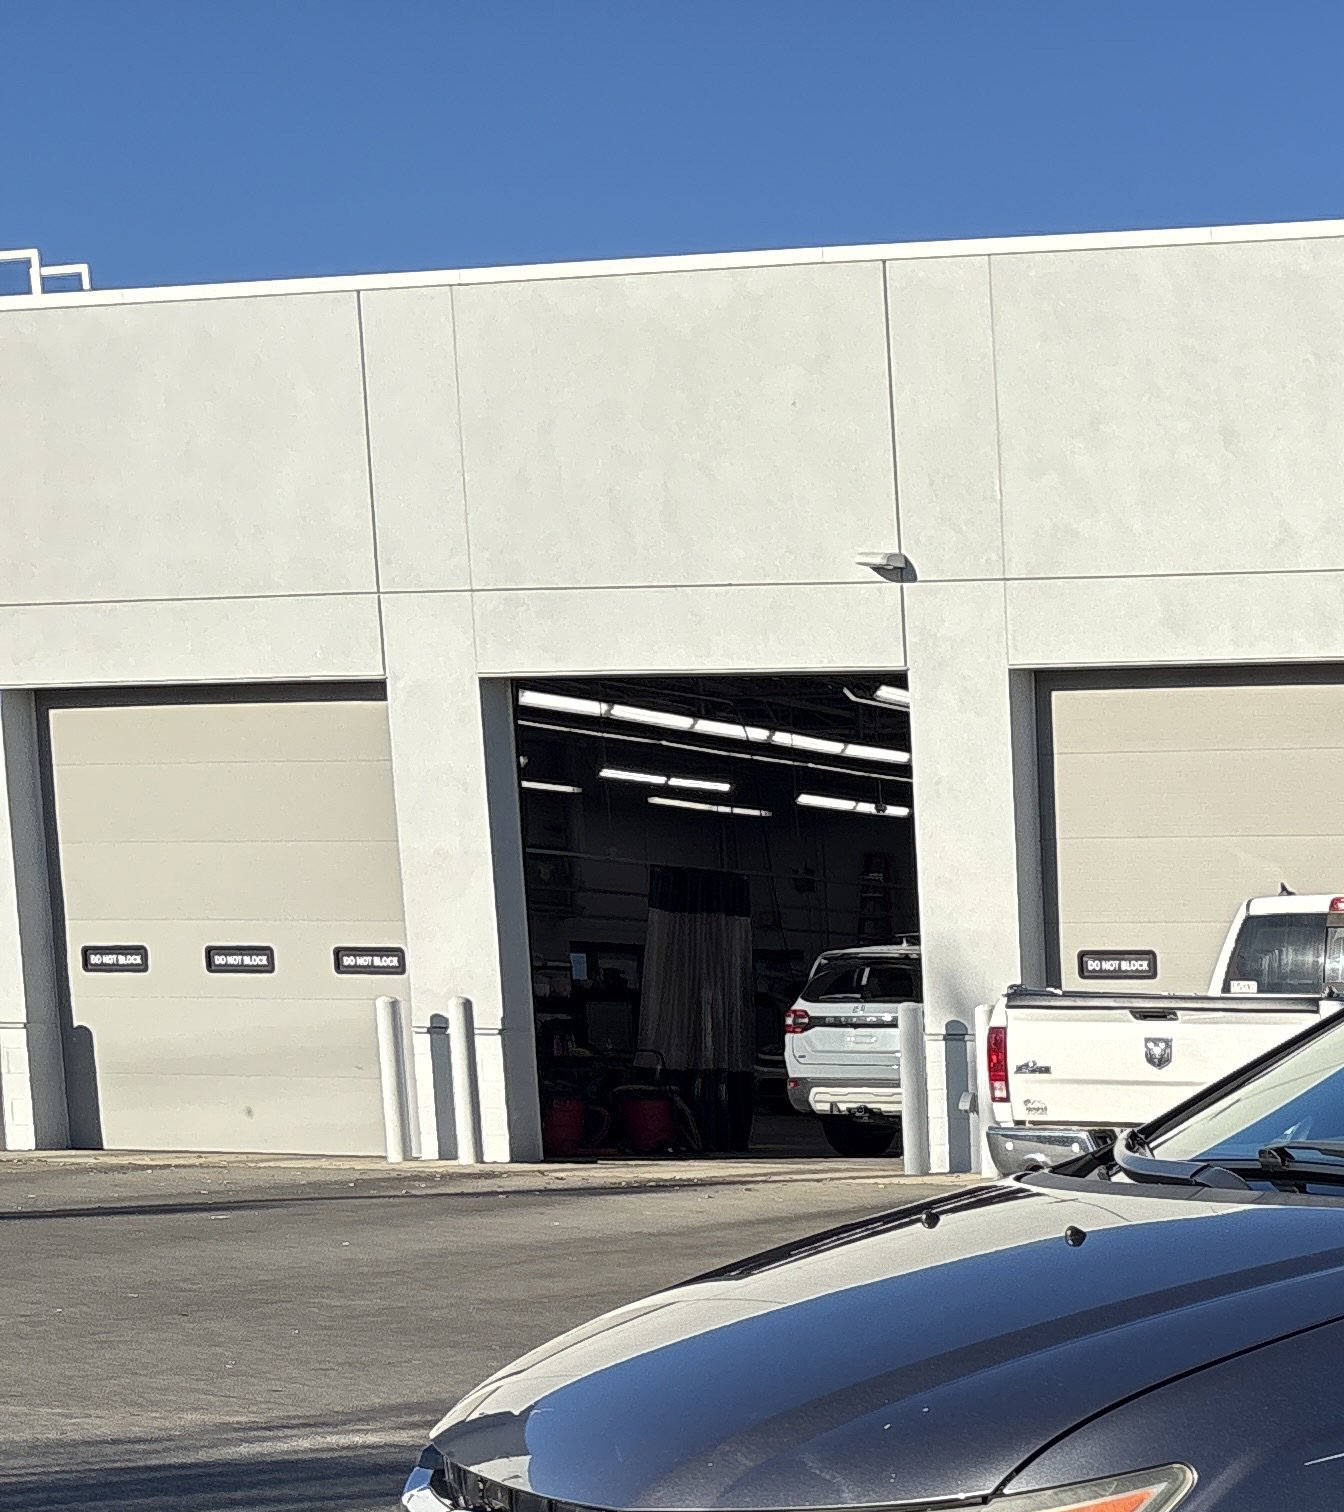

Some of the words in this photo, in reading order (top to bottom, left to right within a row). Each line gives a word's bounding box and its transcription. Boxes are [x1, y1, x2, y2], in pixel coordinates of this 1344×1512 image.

[89, 954, 103, 965] DO
[102, 954, 118, 965] NOT
[118, 954, 143, 965] BLOCK
[214, 955, 227, 965] DO
[226, 955, 243, 966] NOT
[243, 955, 269, 966] BLOCK
[342, 956, 356, 966] DO
[356, 956, 373, 967] NOT
[373, 956, 399, 967] BLOCK
[1087, 960, 1100, 971] DO
[1102, 960, 1119, 971] NOT
[1120, 960, 1149, 971] BLOCK
